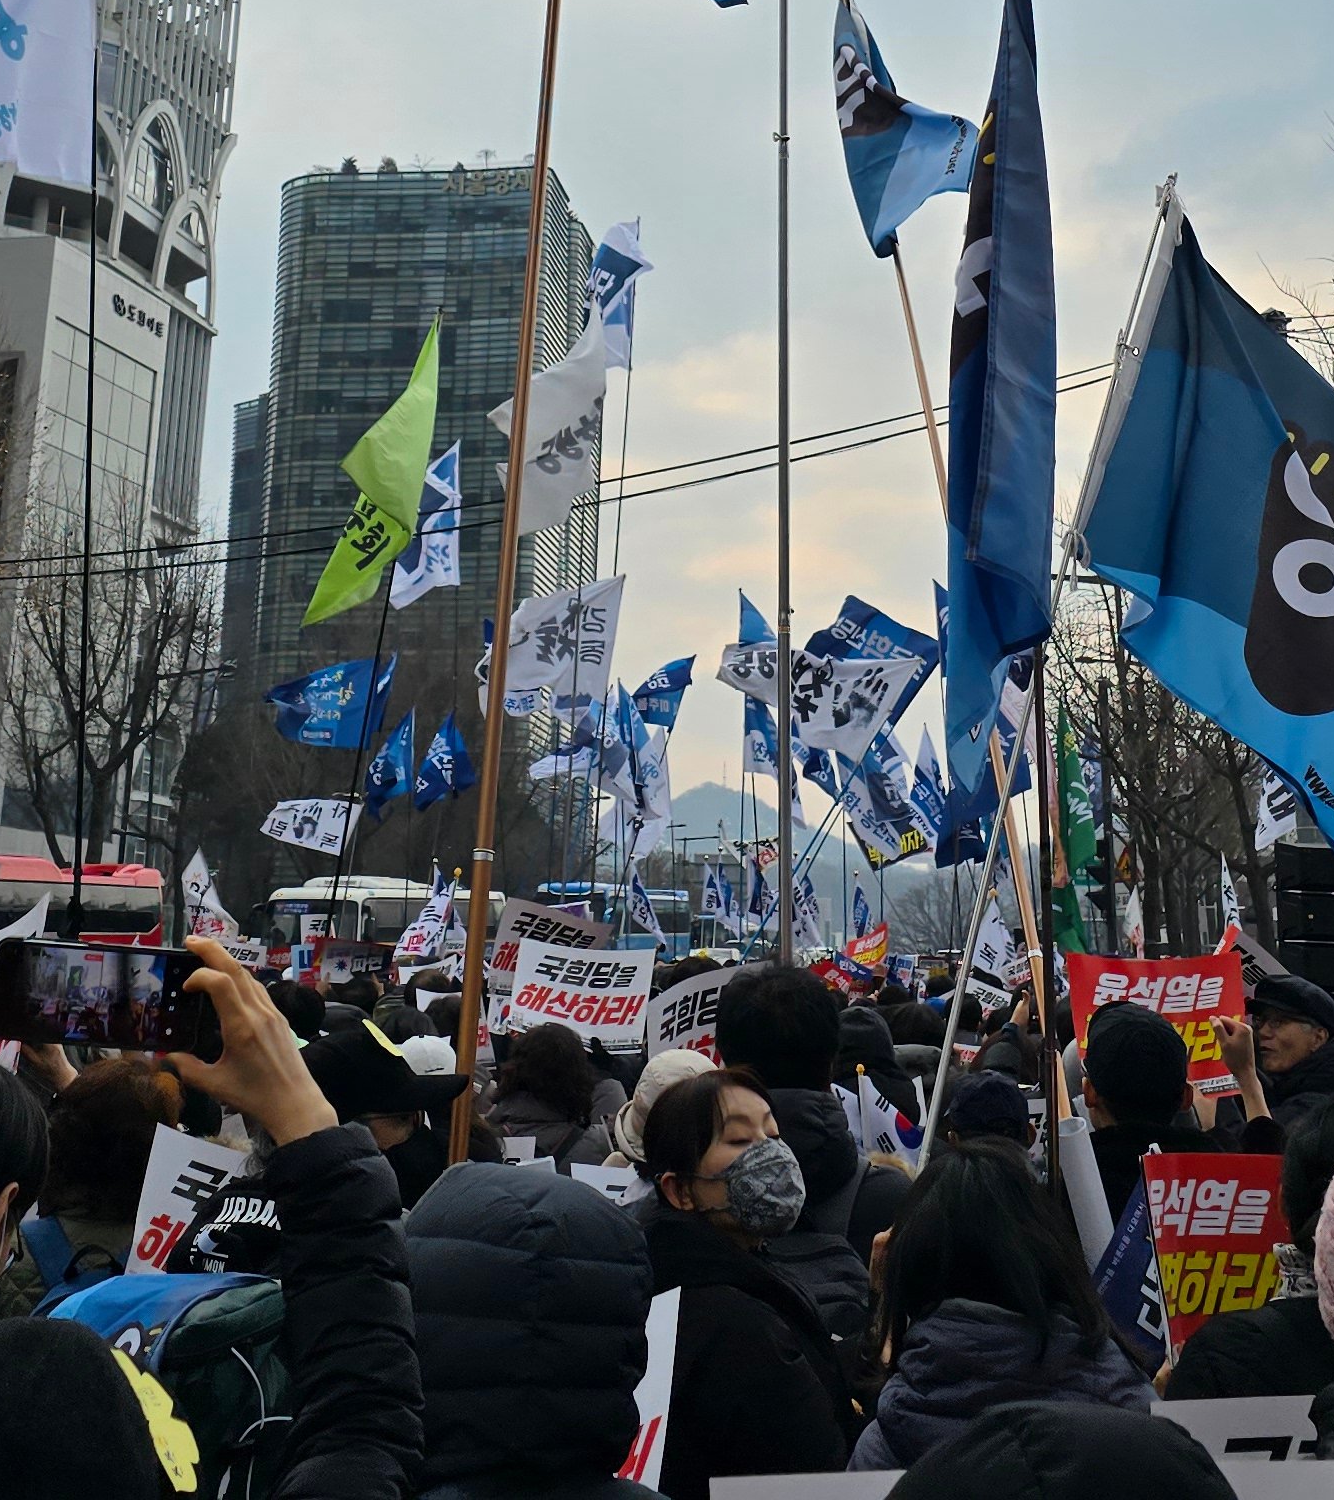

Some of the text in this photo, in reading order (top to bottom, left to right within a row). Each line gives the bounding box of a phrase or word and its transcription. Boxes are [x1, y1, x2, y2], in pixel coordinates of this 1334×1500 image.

[534, 954, 638, 989] 국힘당을
[514, 983, 646, 1027] 해산하라!
[1093, 972, 1224, 1014] 윤석열을
